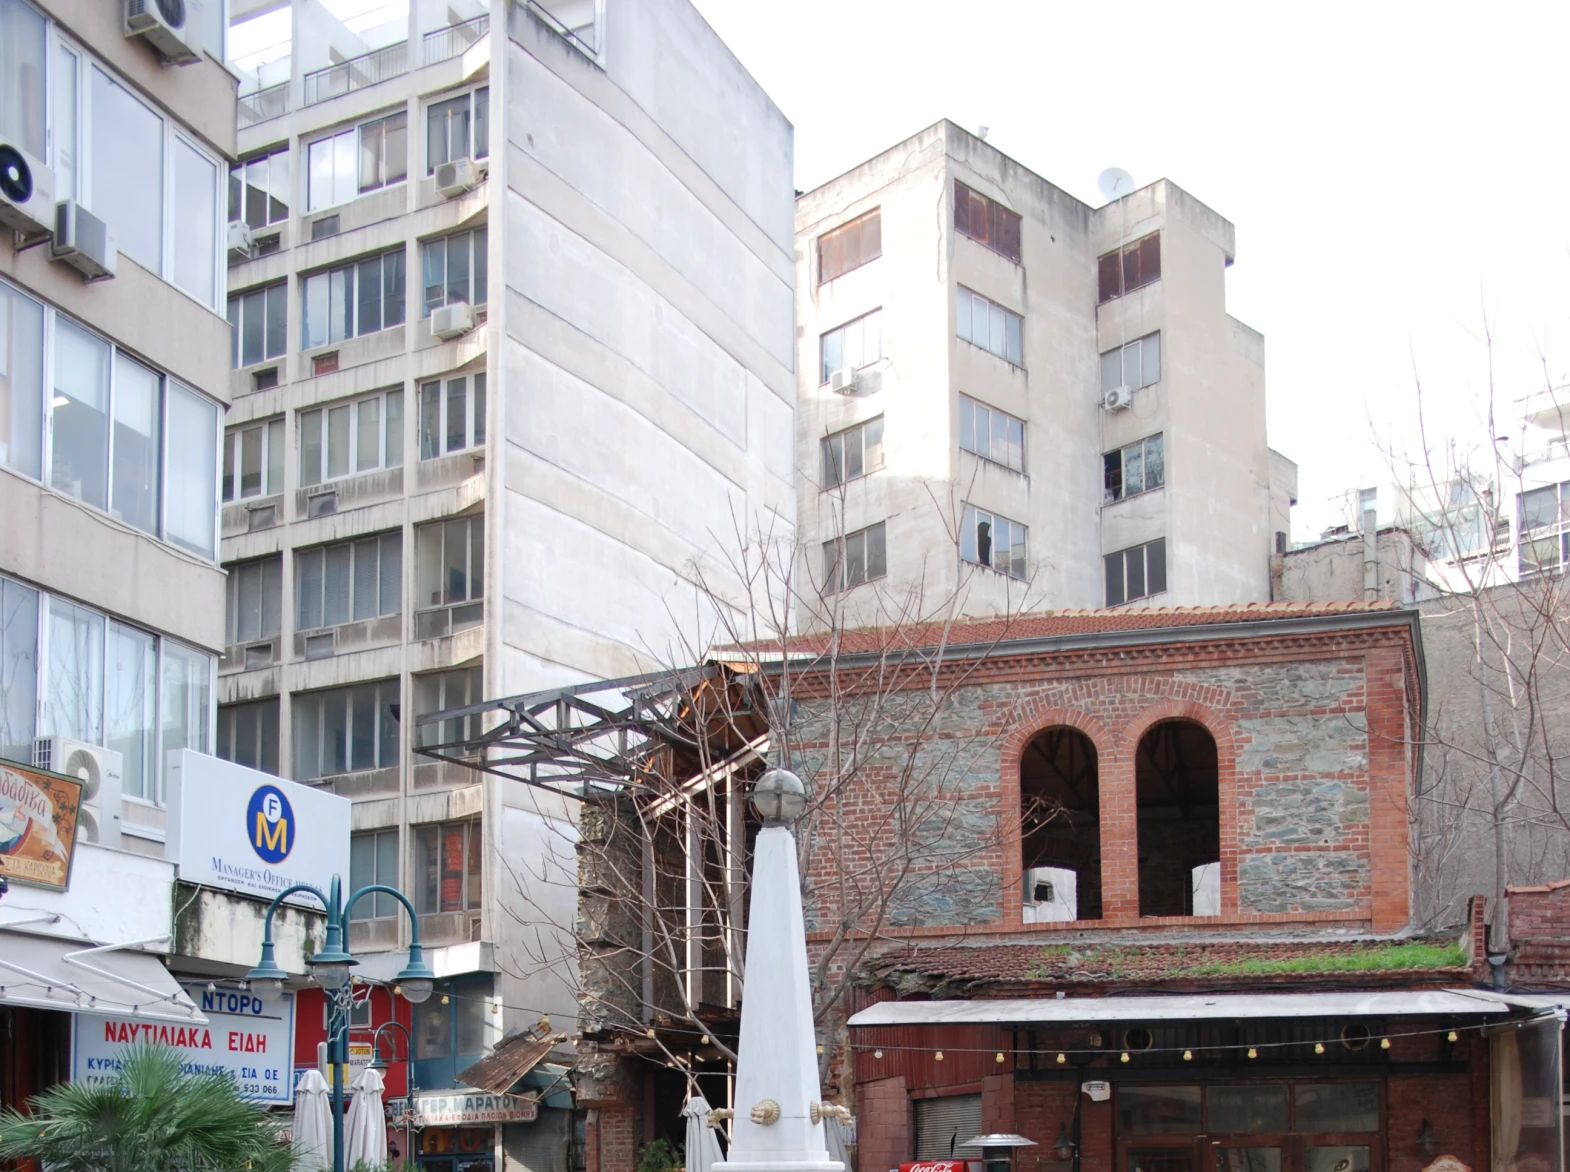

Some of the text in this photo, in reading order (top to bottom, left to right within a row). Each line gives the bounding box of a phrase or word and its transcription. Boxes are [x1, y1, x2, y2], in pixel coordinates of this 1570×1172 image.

[268, 798, 278, 816] F
[256, 811, 287, 854] M
[202, 990, 263, 1015] ΝΤΟΡΟ
[105, 1021, 267, 1054] ΝΑΥΤΙΛΙΑΚΑ ΕΙΔΗ
[241, 1067, 257, 1079] ΣΙΑ
[244, 1083, 278, 1095] 533 066
